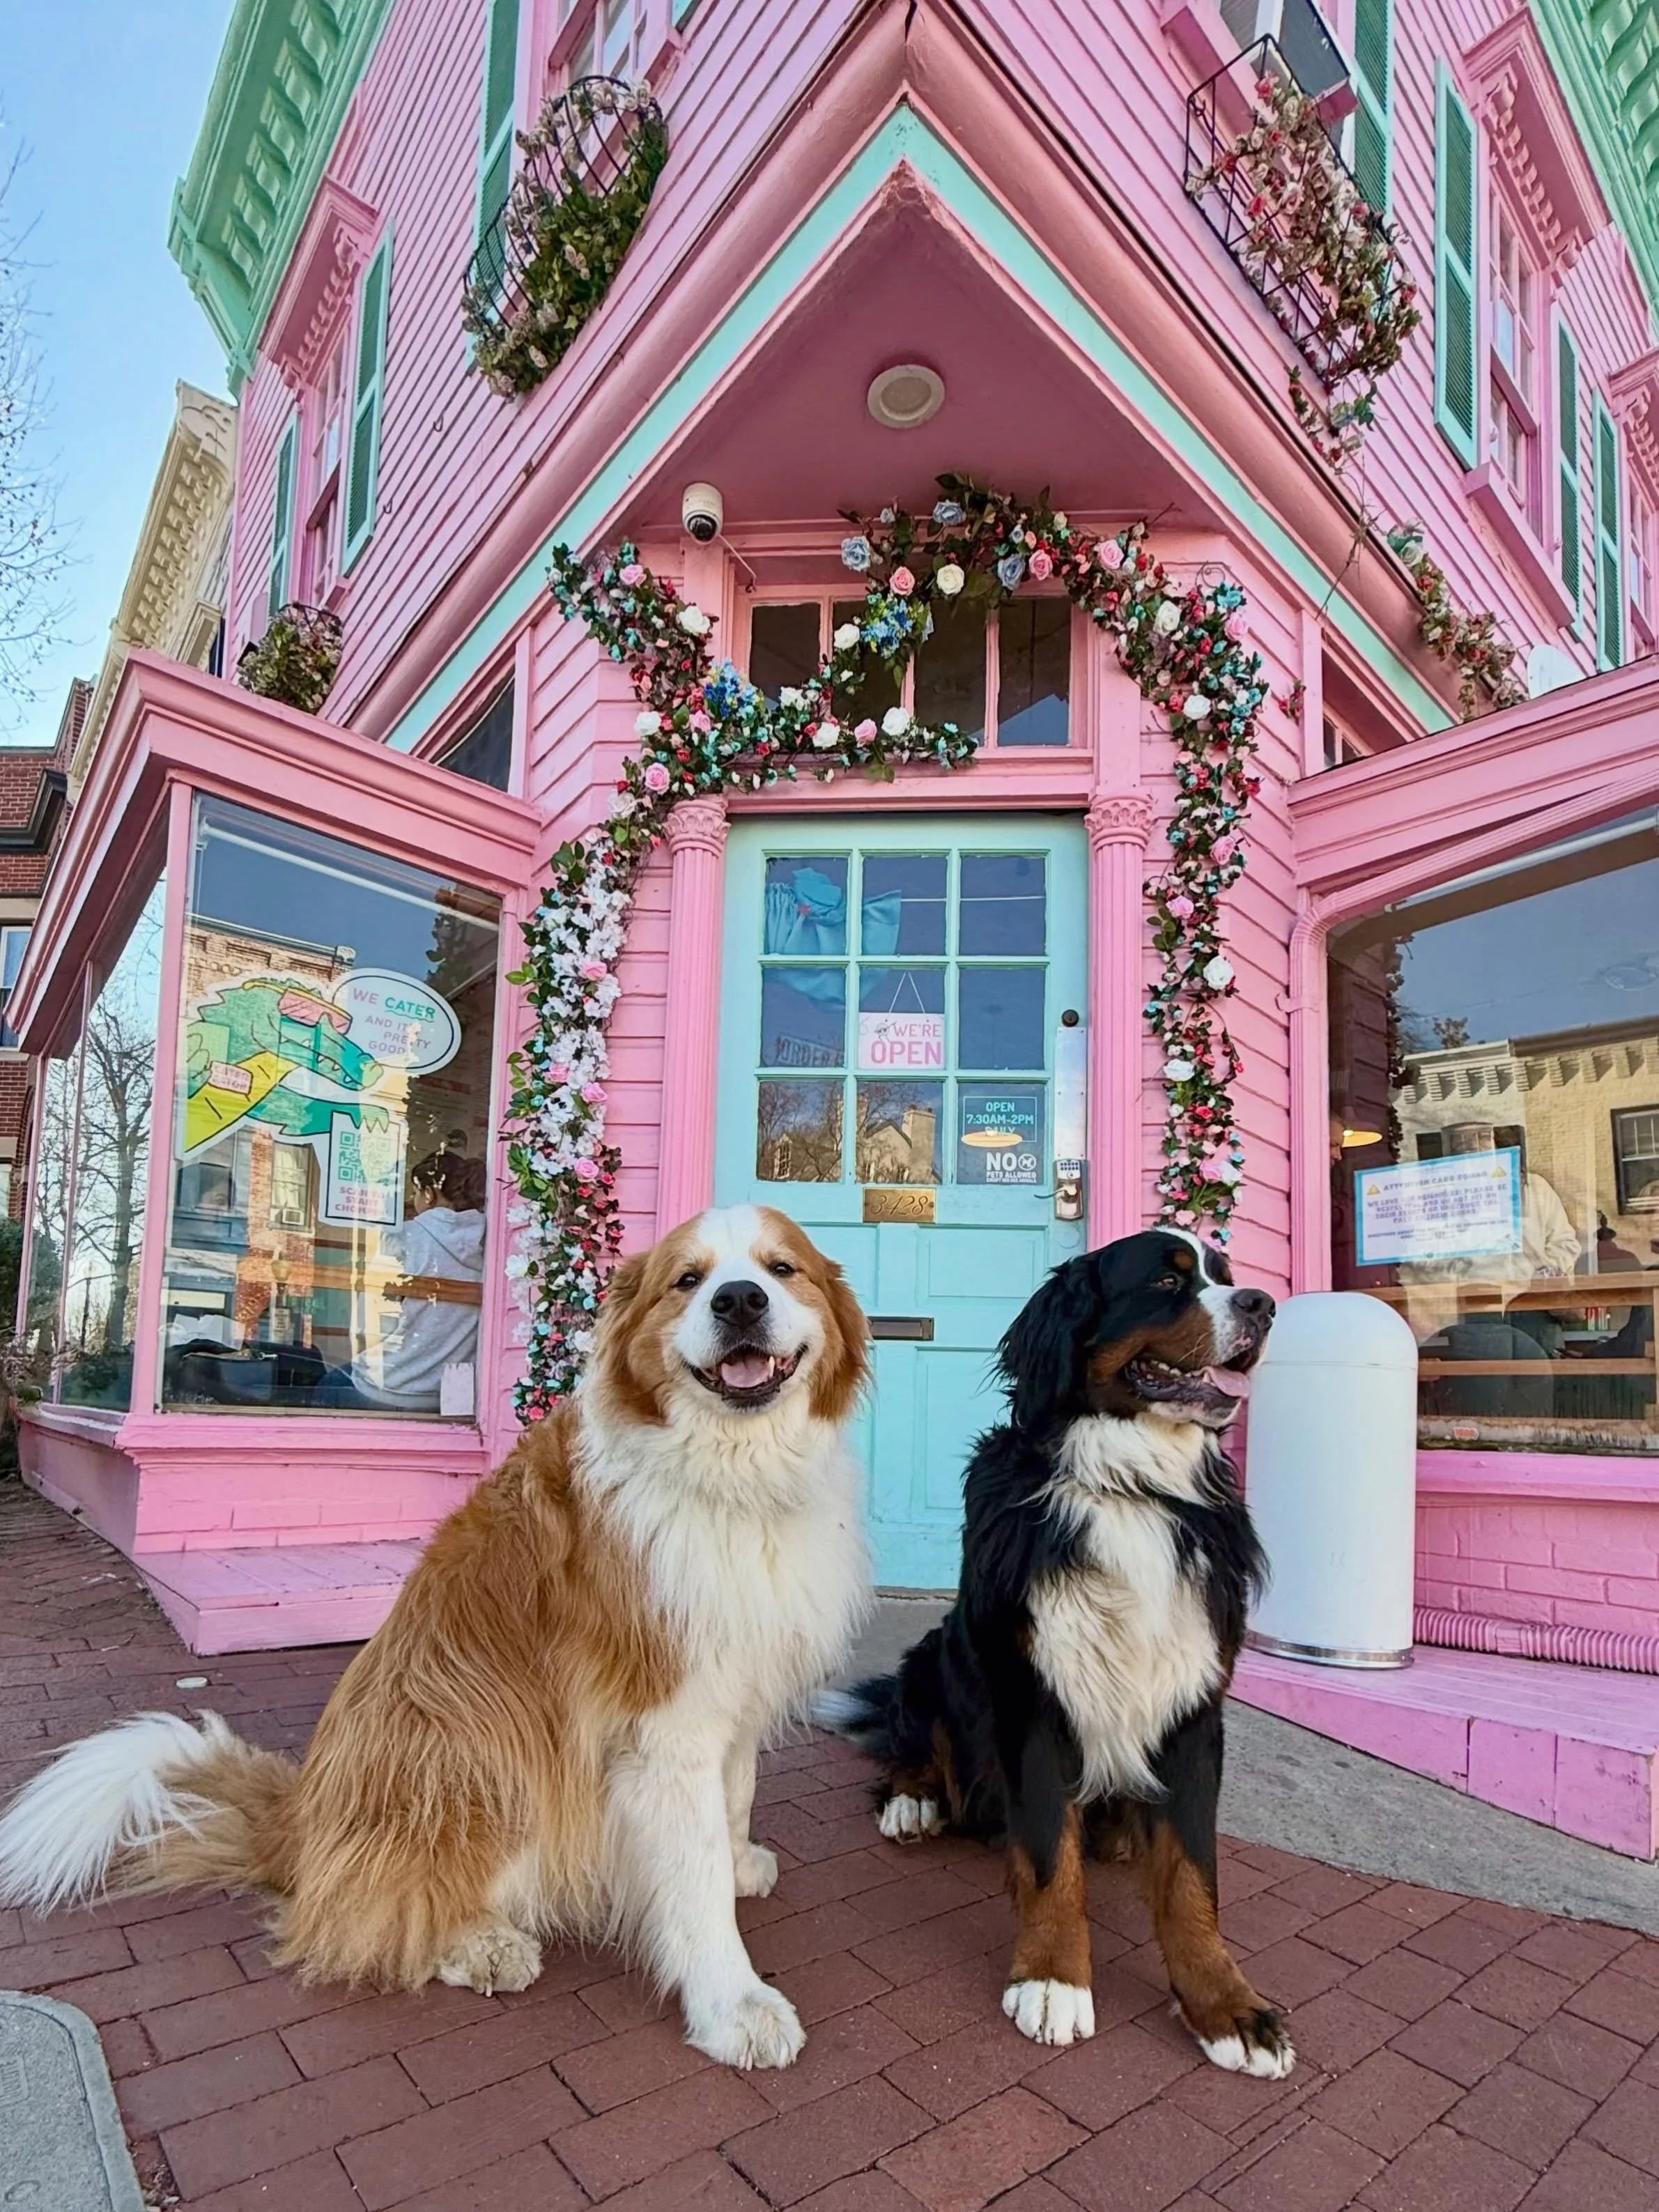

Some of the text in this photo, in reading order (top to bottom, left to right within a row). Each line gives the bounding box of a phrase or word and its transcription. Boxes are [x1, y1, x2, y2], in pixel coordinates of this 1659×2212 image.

[353, 988, 435, 1019] WE CATER
[364, 1015, 419, 1034] AND IT'
[893, 1023, 942, 1037] WE'RE
[384, 1031, 431, 1049] PRETY
[870, 1040, 942, 1065] OPEN
[985, 1102, 1015, 1112] OPEN
[966, 1114, 1034, 1125] 7:30AM-2PM
[986, 1152, 1017, 1172] NO
[870, 1195, 929, 1215] 3428
